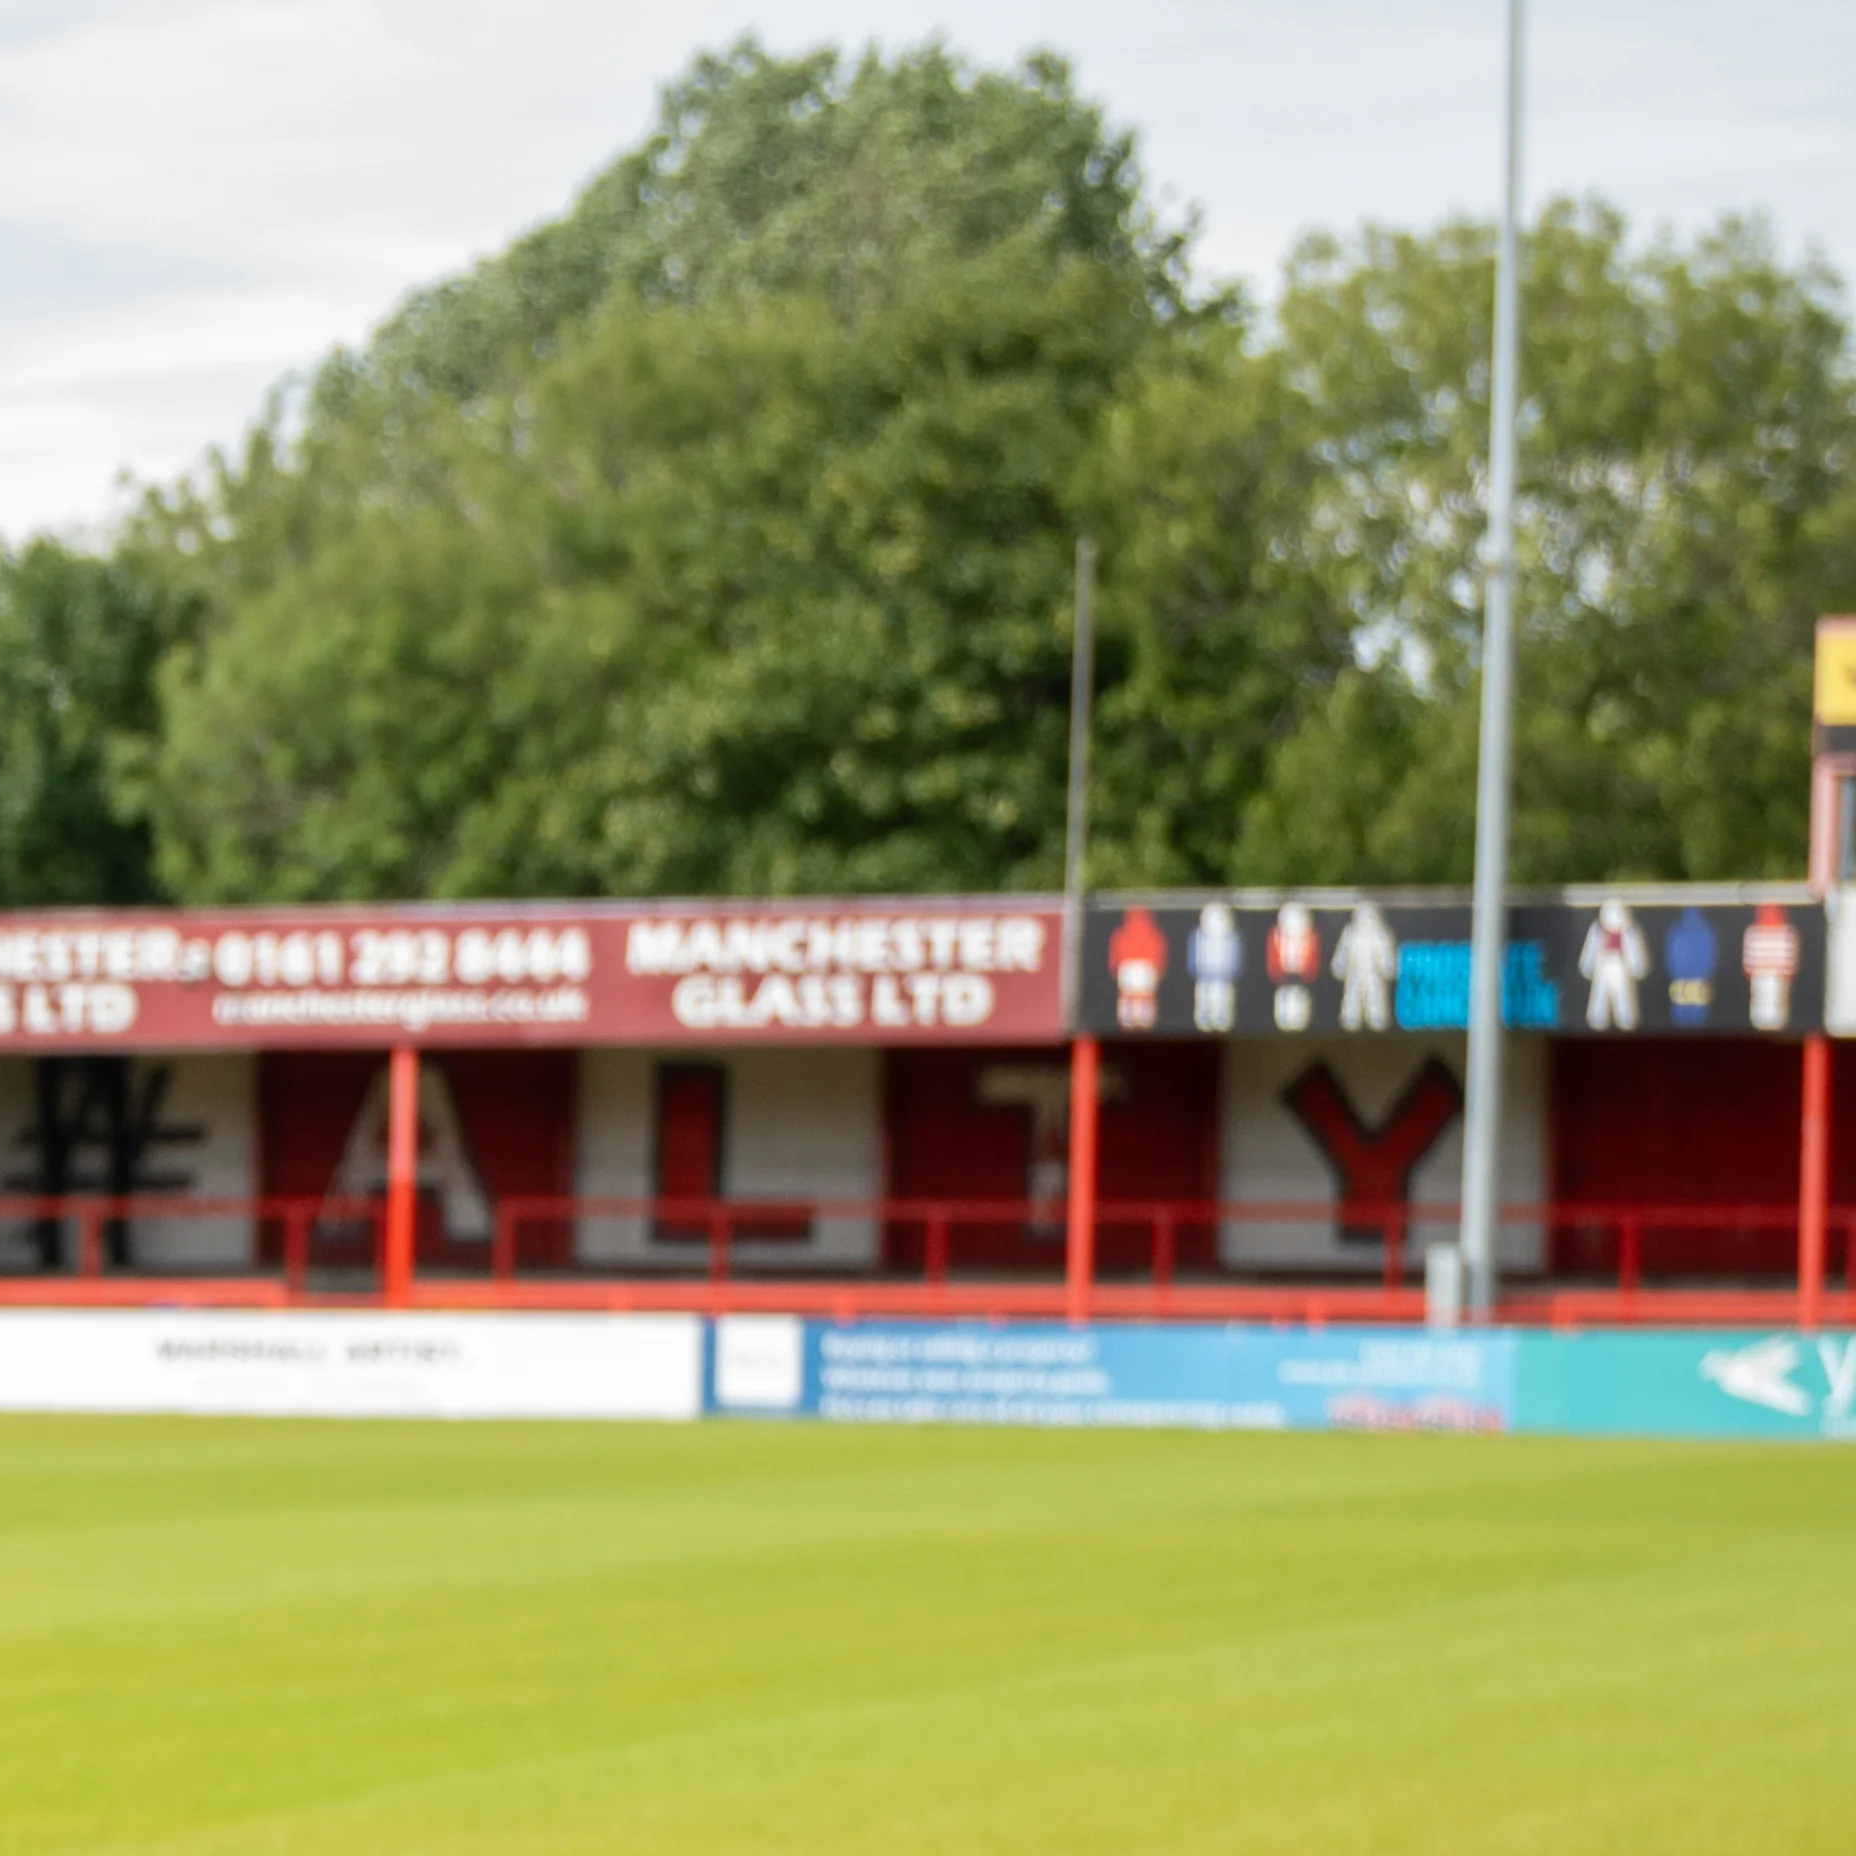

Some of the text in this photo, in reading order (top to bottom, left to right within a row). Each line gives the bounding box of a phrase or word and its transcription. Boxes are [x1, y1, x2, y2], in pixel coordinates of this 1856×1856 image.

[212, 930, 344, 986] 0161
[625, 917, 1045, 975] MANCHESTER
[22, 983, 139, 1034] LTD
[672, 974, 994, 1029] GLASS LTD
